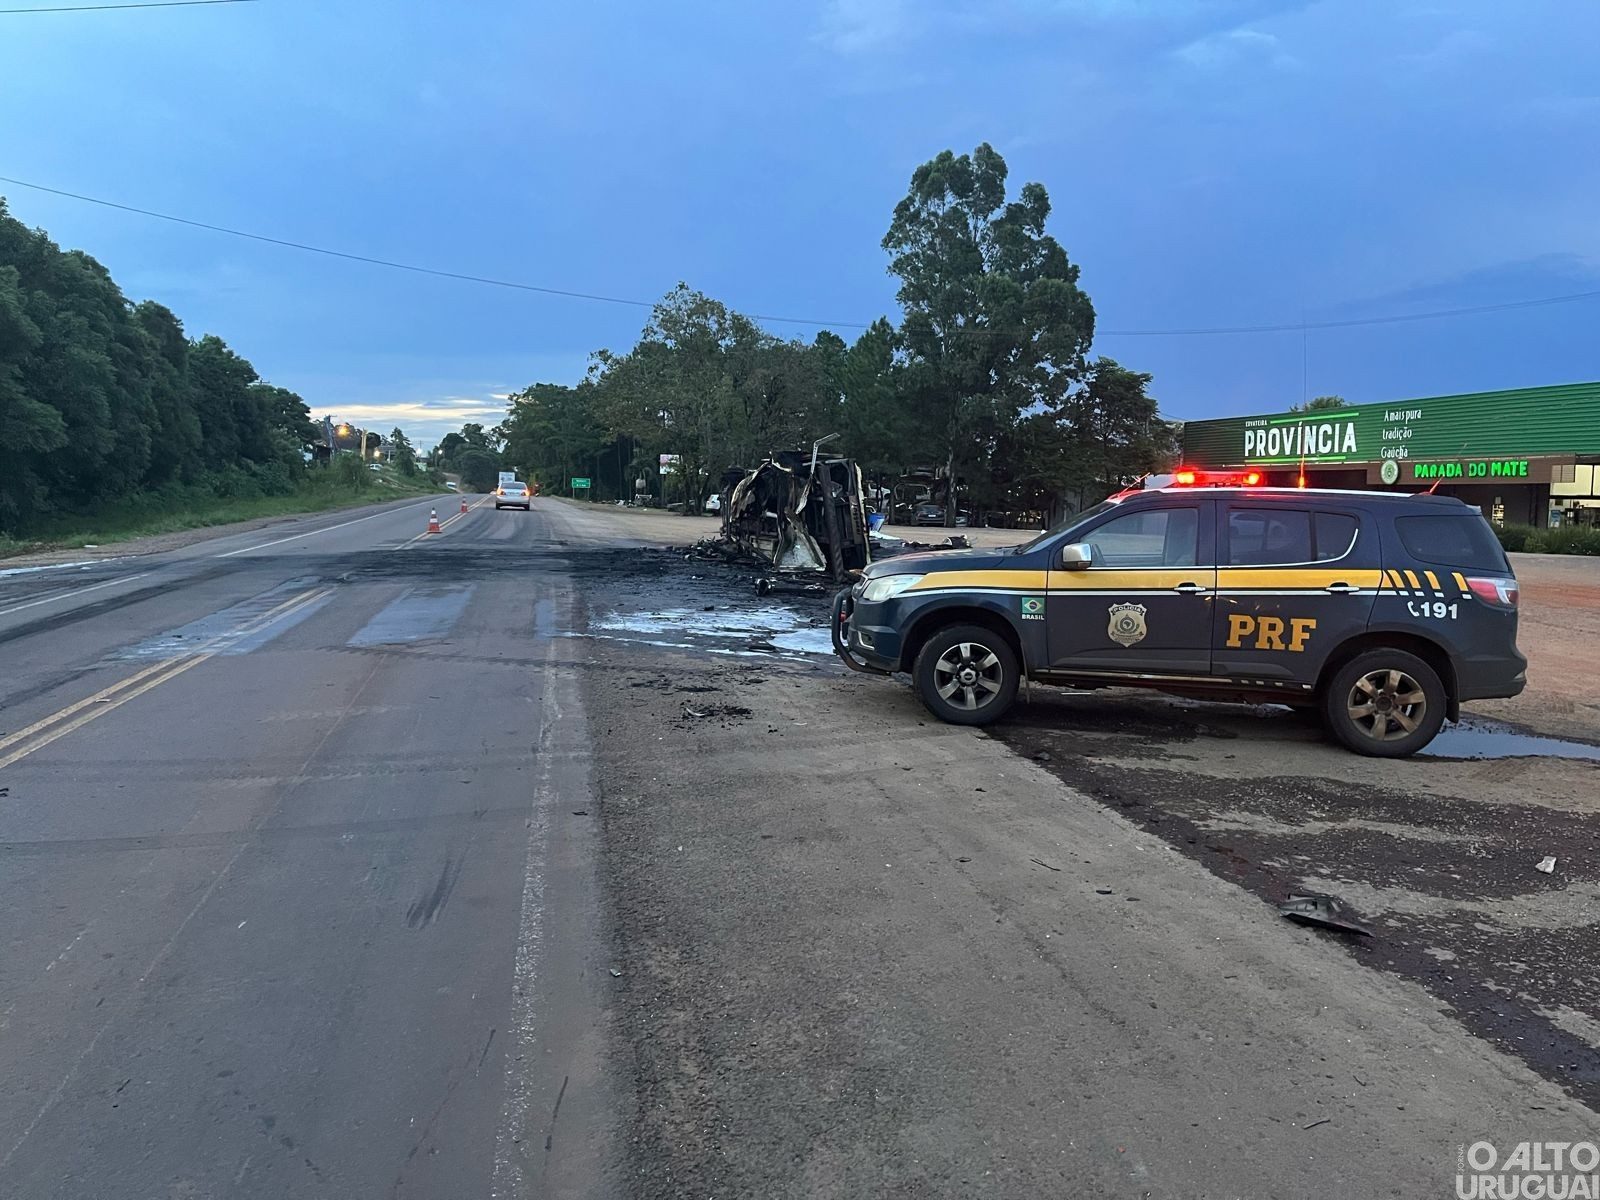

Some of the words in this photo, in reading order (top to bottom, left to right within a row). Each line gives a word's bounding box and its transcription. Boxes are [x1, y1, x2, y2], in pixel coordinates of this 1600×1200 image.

[1384, 410, 1389, 422] A
[1389, 408, 1405, 421] mais
[1405, 409, 1422, 424] pura
[1244, 421, 1357, 457] PROVÍNCIA
[1382, 427, 1412, 440] tradição
[1381, 445, 1408, 459] Gaúcha
[1414, 463, 1463, 478] PARADA
[1468, 462, 1487, 477] DO
[1491, 461, 1528, 477] MATE
[1420, 601, 1458, 619] 191
[1226, 614, 1317, 652] PRF
